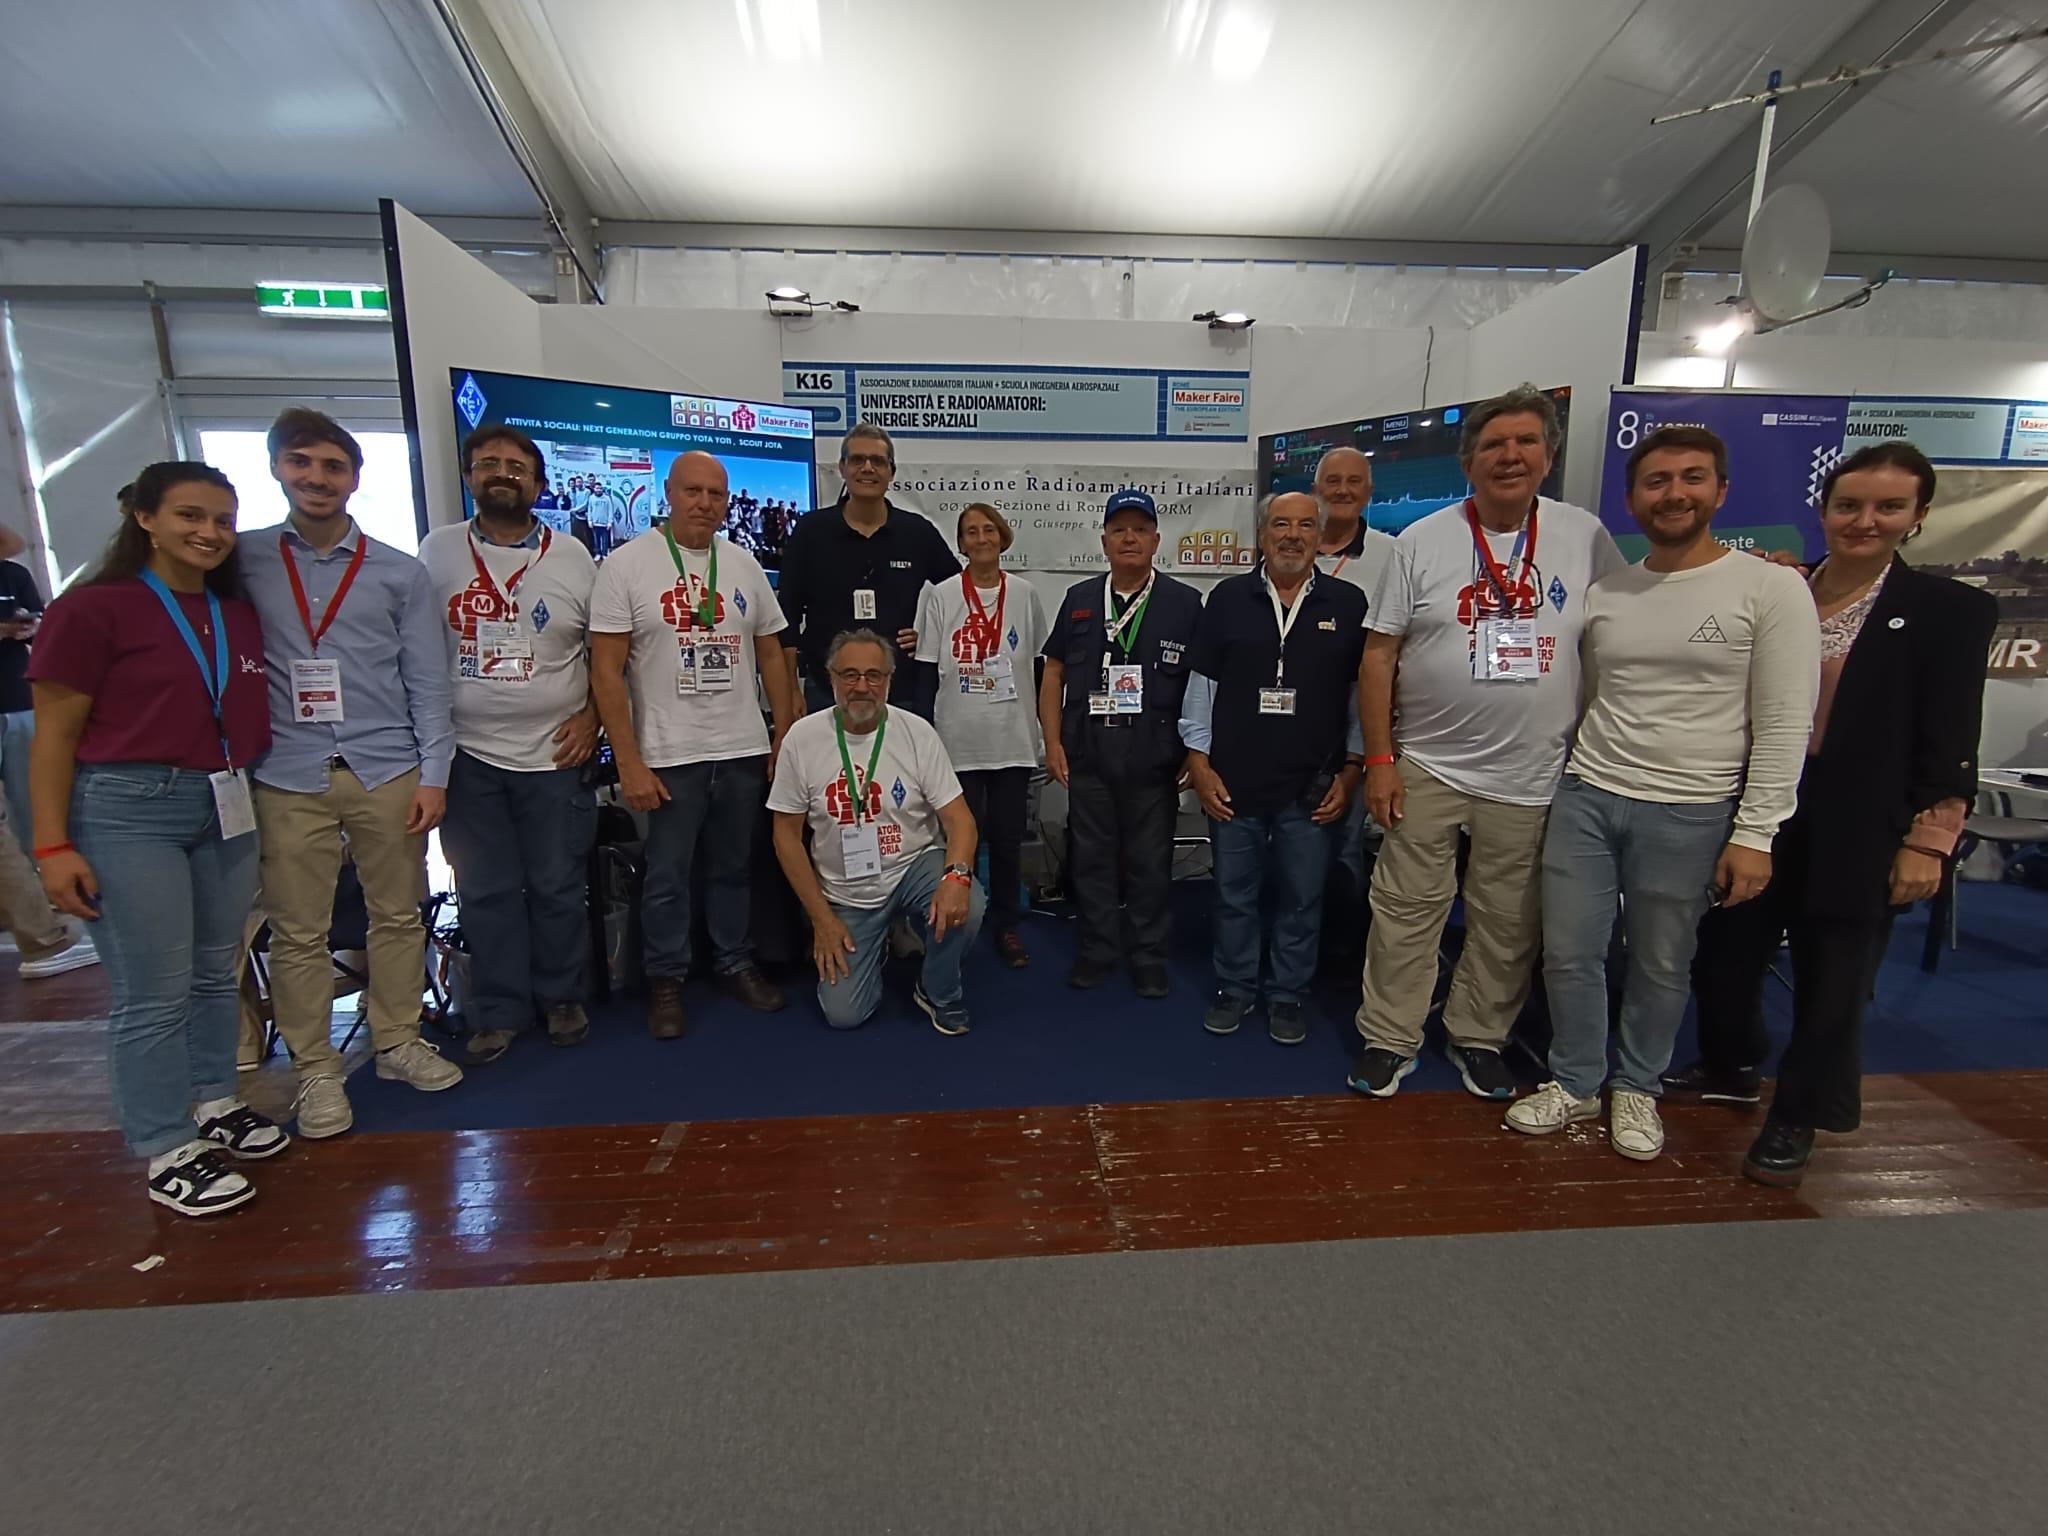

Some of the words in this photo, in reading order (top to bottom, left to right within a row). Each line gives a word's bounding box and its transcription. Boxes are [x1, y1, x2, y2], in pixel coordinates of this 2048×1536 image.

[796, 373, 833, 390] K16
[860, 378, 911, 388] ASSOCIAZIONE
[912, 379, 963, 389] RADIOAMATORI
[965, 380, 993, 389] ITALIANI
[1001, 380, 1028, 390] SCUOLA
[1030, 381, 1070, 391] INGEGNERIA
[1071, 382, 1120, 392] AEROSPAZIALE
[937, 395, 945, 410] E
[948, 395, 1047, 411] RADIOAMATORI:
[1175, 391, 1210, 403] Maker
[1213, 392, 1241, 404] Faire
[761, 416, 788, 427] Maker
[789, 419, 809, 429] Faire
[861, 412, 919, 428] SINERGIE
[922, 413, 978, 428] SPAZIALI
[1779, 413, 1809, 421] CASSINI
[1385, 420, 1406, 429] MENU
[1616, 410, 1639, 450] 8
[583, 424, 604, 433] NEXT
[605, 426, 657, 438] GENERATION
[659, 431, 691, 441] GRUPPO
[693, 434, 714, 444] YOTA
[739, 438, 763, 448] SCOUT
[764, 440, 783, 449] JOTA
[1382, 433, 1409, 442] Maestro
[1274, 452, 1286, 462] TX
[886, 477, 1017, 491] ssociazione
[1027, 476, 1166, 495] Radioamatori
[1177, 480, 1255, 497] Italiani
[993, 499, 1051, 512] Sezione
[1056, 500, 1071, 512] di
[1034, 518, 1085, 531] Giuseppe
[474, 597, 491, 612] M
